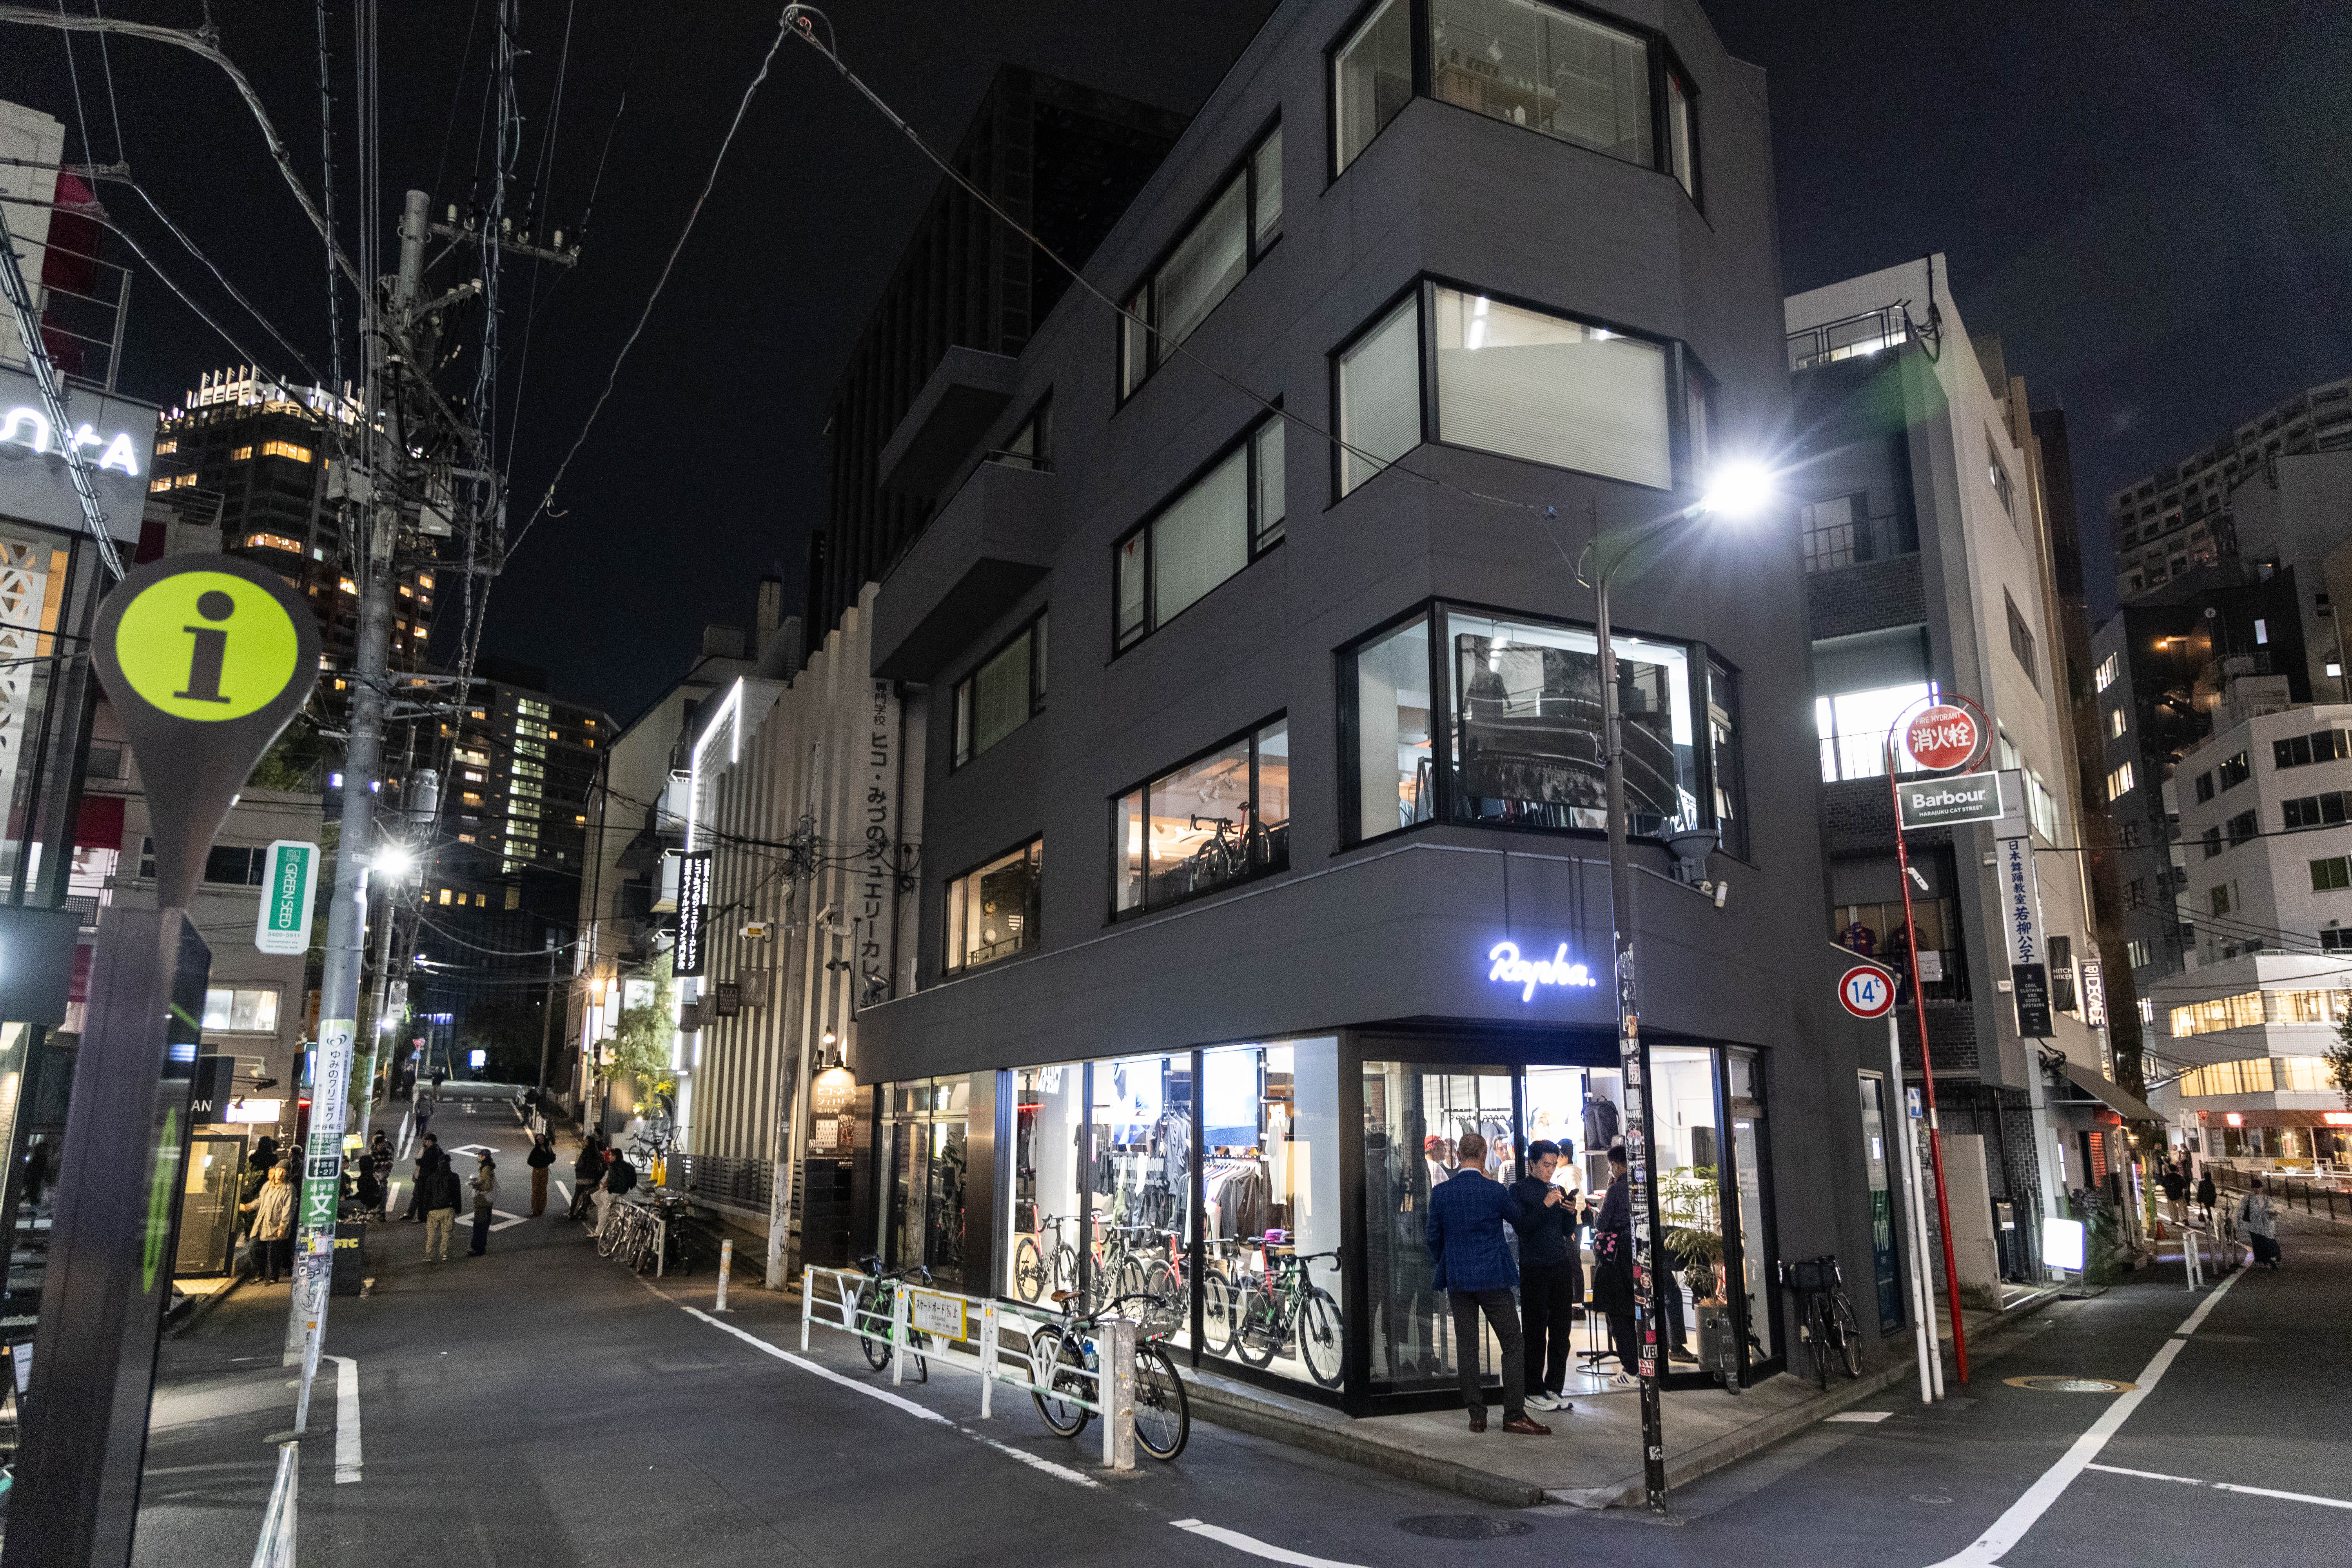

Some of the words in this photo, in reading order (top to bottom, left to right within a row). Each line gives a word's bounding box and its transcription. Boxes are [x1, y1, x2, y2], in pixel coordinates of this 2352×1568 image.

[873, 682, 887, 726] 専門学校
[1915, 717, 1929, 725] FIRE
[1931, 712, 1962, 722] HYDRANT
[1912, 722, 1971, 753] 消火栓
[1912, 789, 1985, 809] Barbour
[861, 732, 888, 975] ヒコ・みづのジュエリーカレ
[282, 863, 298, 899] GREEN
[279, 900, 293, 929] SEED
[326, 1050, 340, 1122] ゆみのクリニック
[309, 1192, 333, 1217] 文
[334, 1238, 359, 1249] FTC
